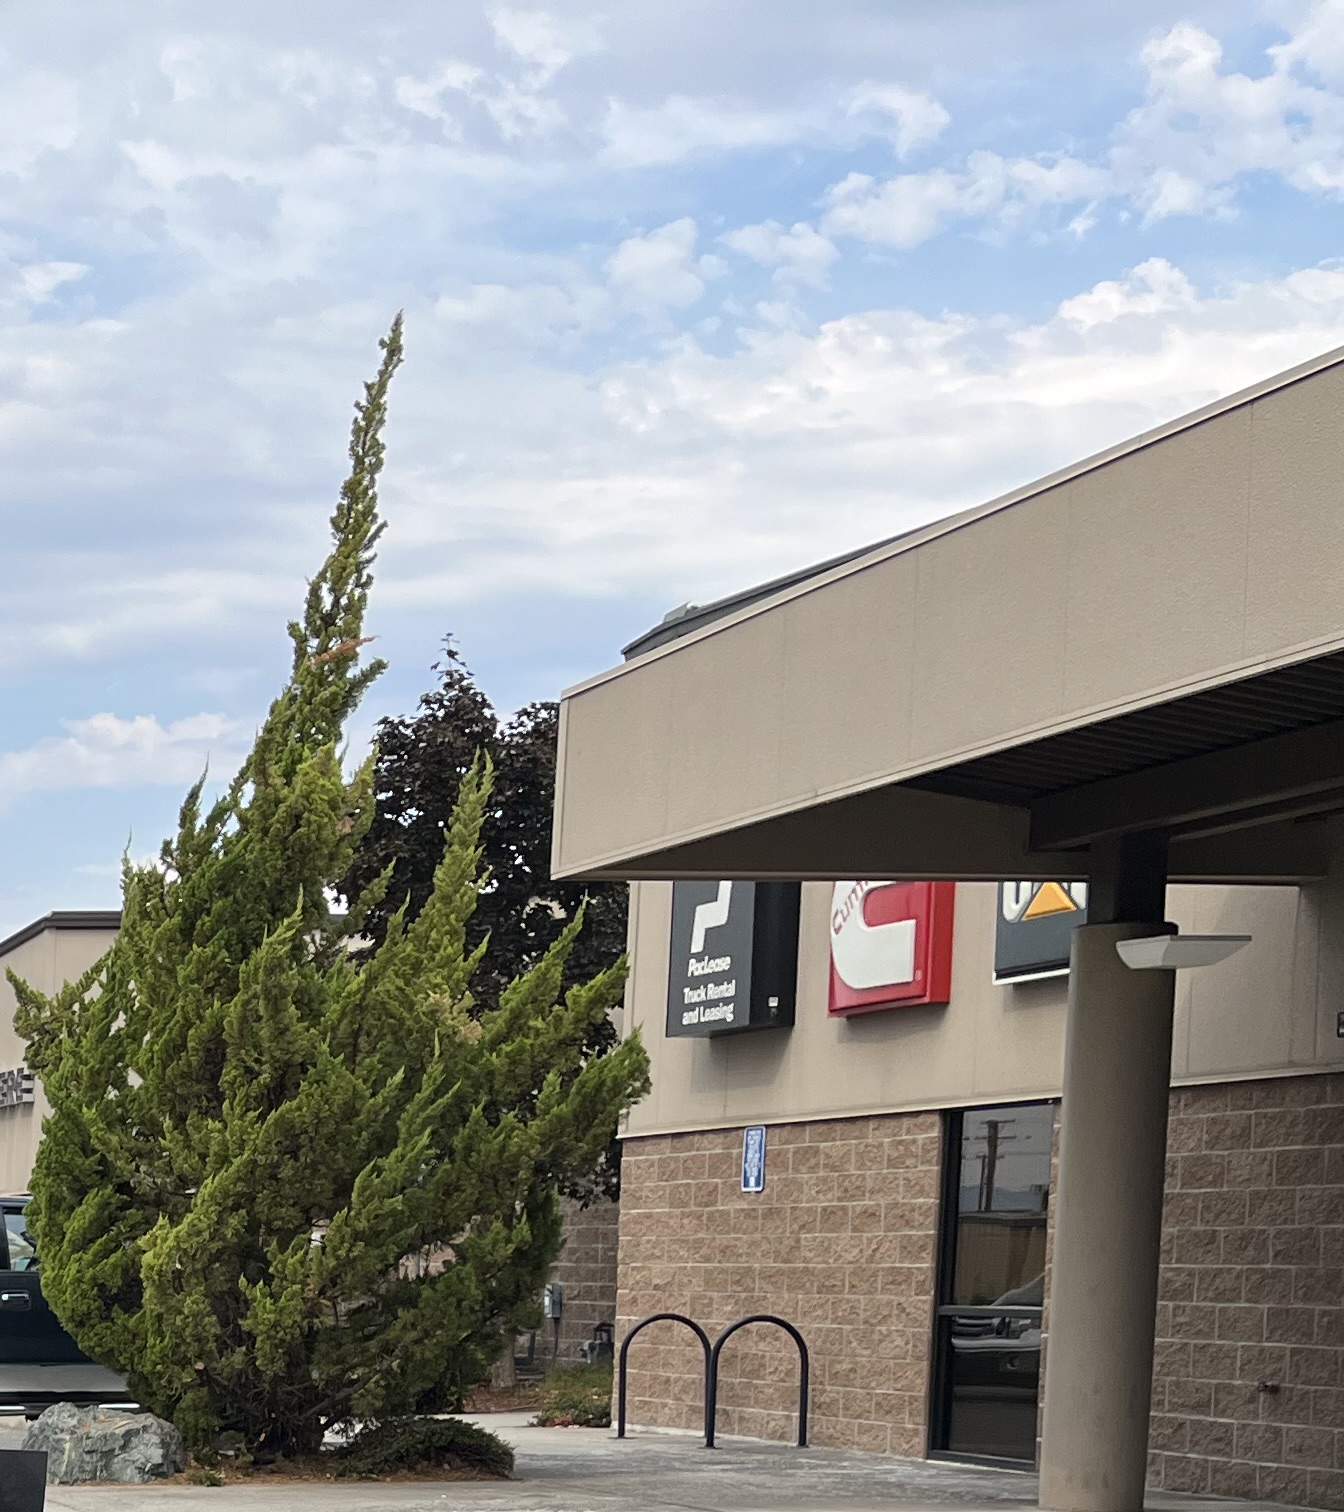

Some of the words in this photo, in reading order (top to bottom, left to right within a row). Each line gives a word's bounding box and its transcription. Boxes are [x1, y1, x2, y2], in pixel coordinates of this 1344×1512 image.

[687, 955, 732, 978] PacLease
[682, 984, 707, 1004] Truck
[707, 979, 737, 1000] Rental
[681, 1006, 699, 1026] and
[699, 1002, 735, 1023] Leasing
